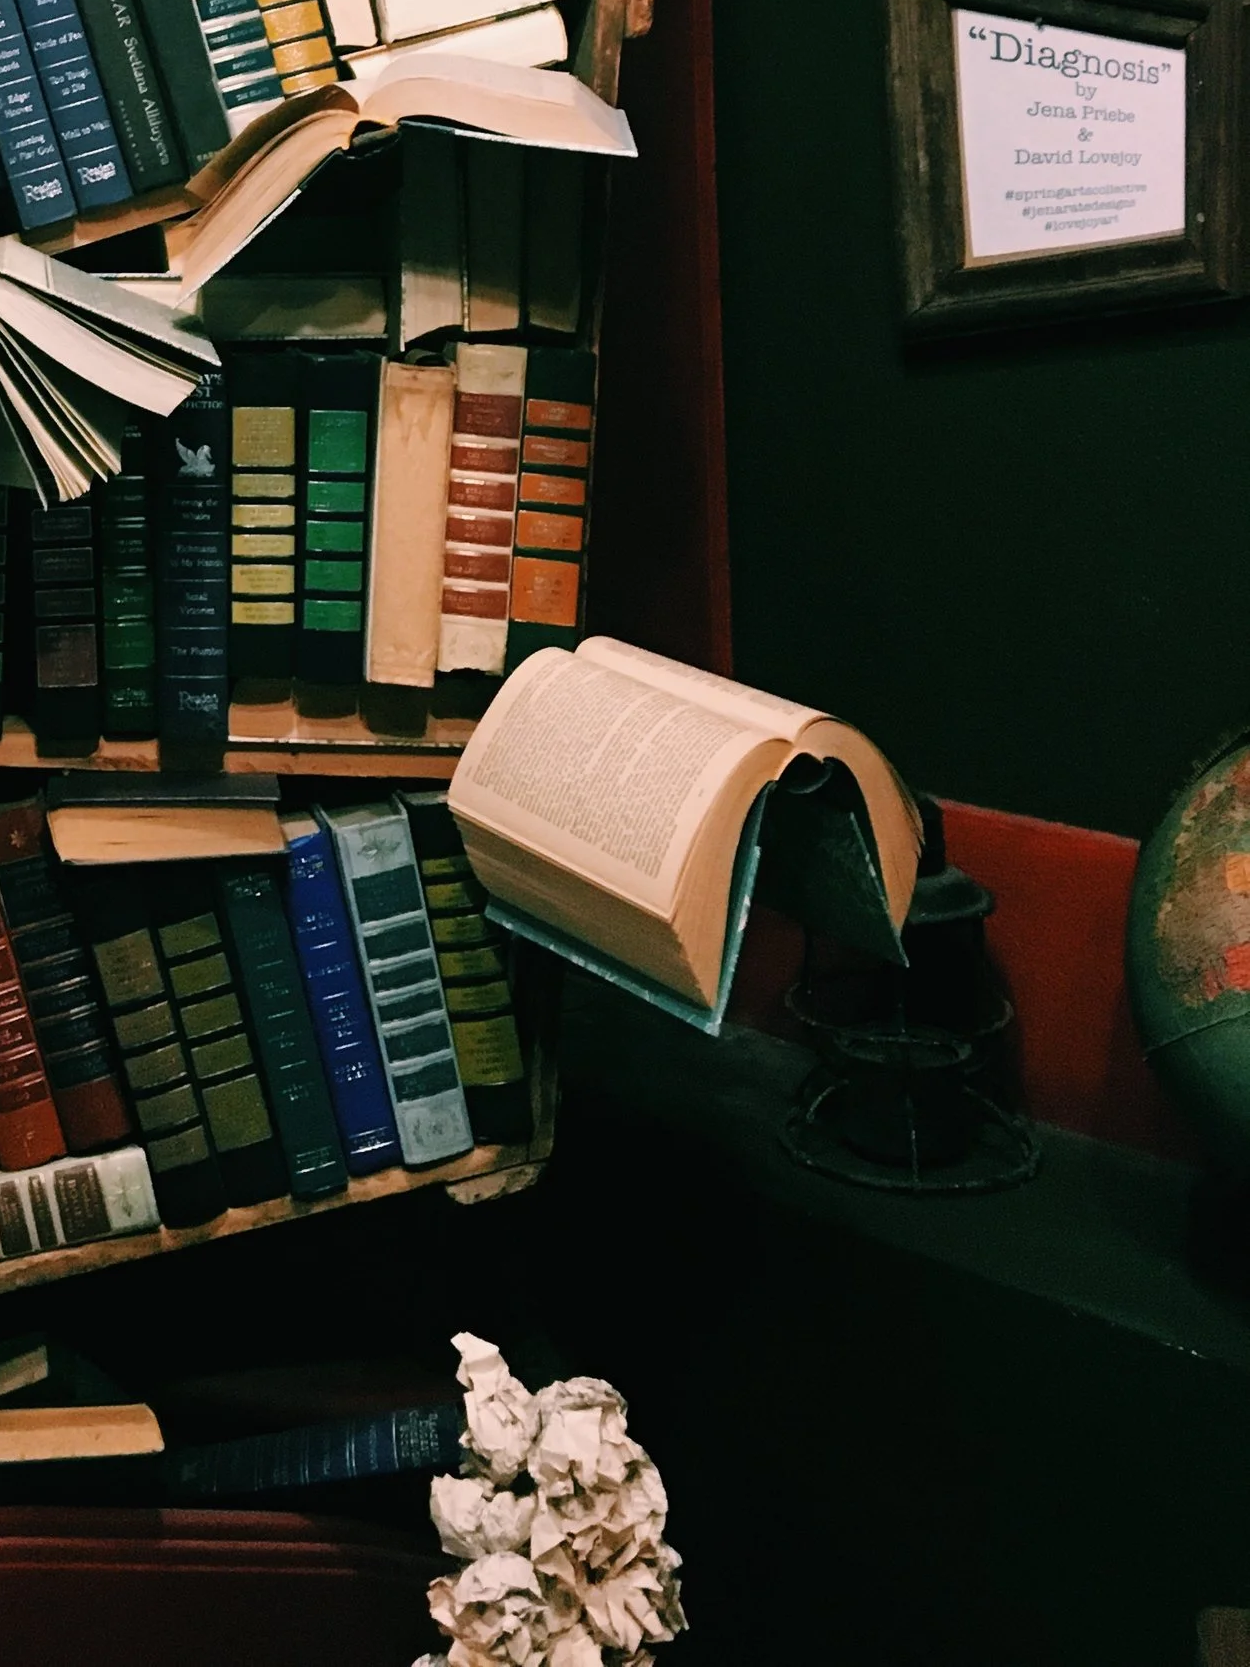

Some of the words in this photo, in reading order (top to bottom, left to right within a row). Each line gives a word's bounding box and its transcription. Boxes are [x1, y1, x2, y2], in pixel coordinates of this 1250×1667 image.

[58, 34, 68, 44] of
[124, 36, 148, 95] Svetlana
[71, 83, 86, 94] Die
[1075, 82, 1097, 100] by
[8, 91, 31, 104] Edgar
[4, 104, 34, 118] Hoover
[1027, 101, 1077, 119] Jena
[1082, 106, 1136, 123] Priebe
[1078, 127, 1094, 142] &
[38, 144, 55, 155] God
[1014, 149, 1073, 165] David
[1079, 151, 1142, 166] Lovejoy
[190, 373, 224, 385] AY'S
[188, 386, 213, 397] ST
[170, 646, 187, 655] The
